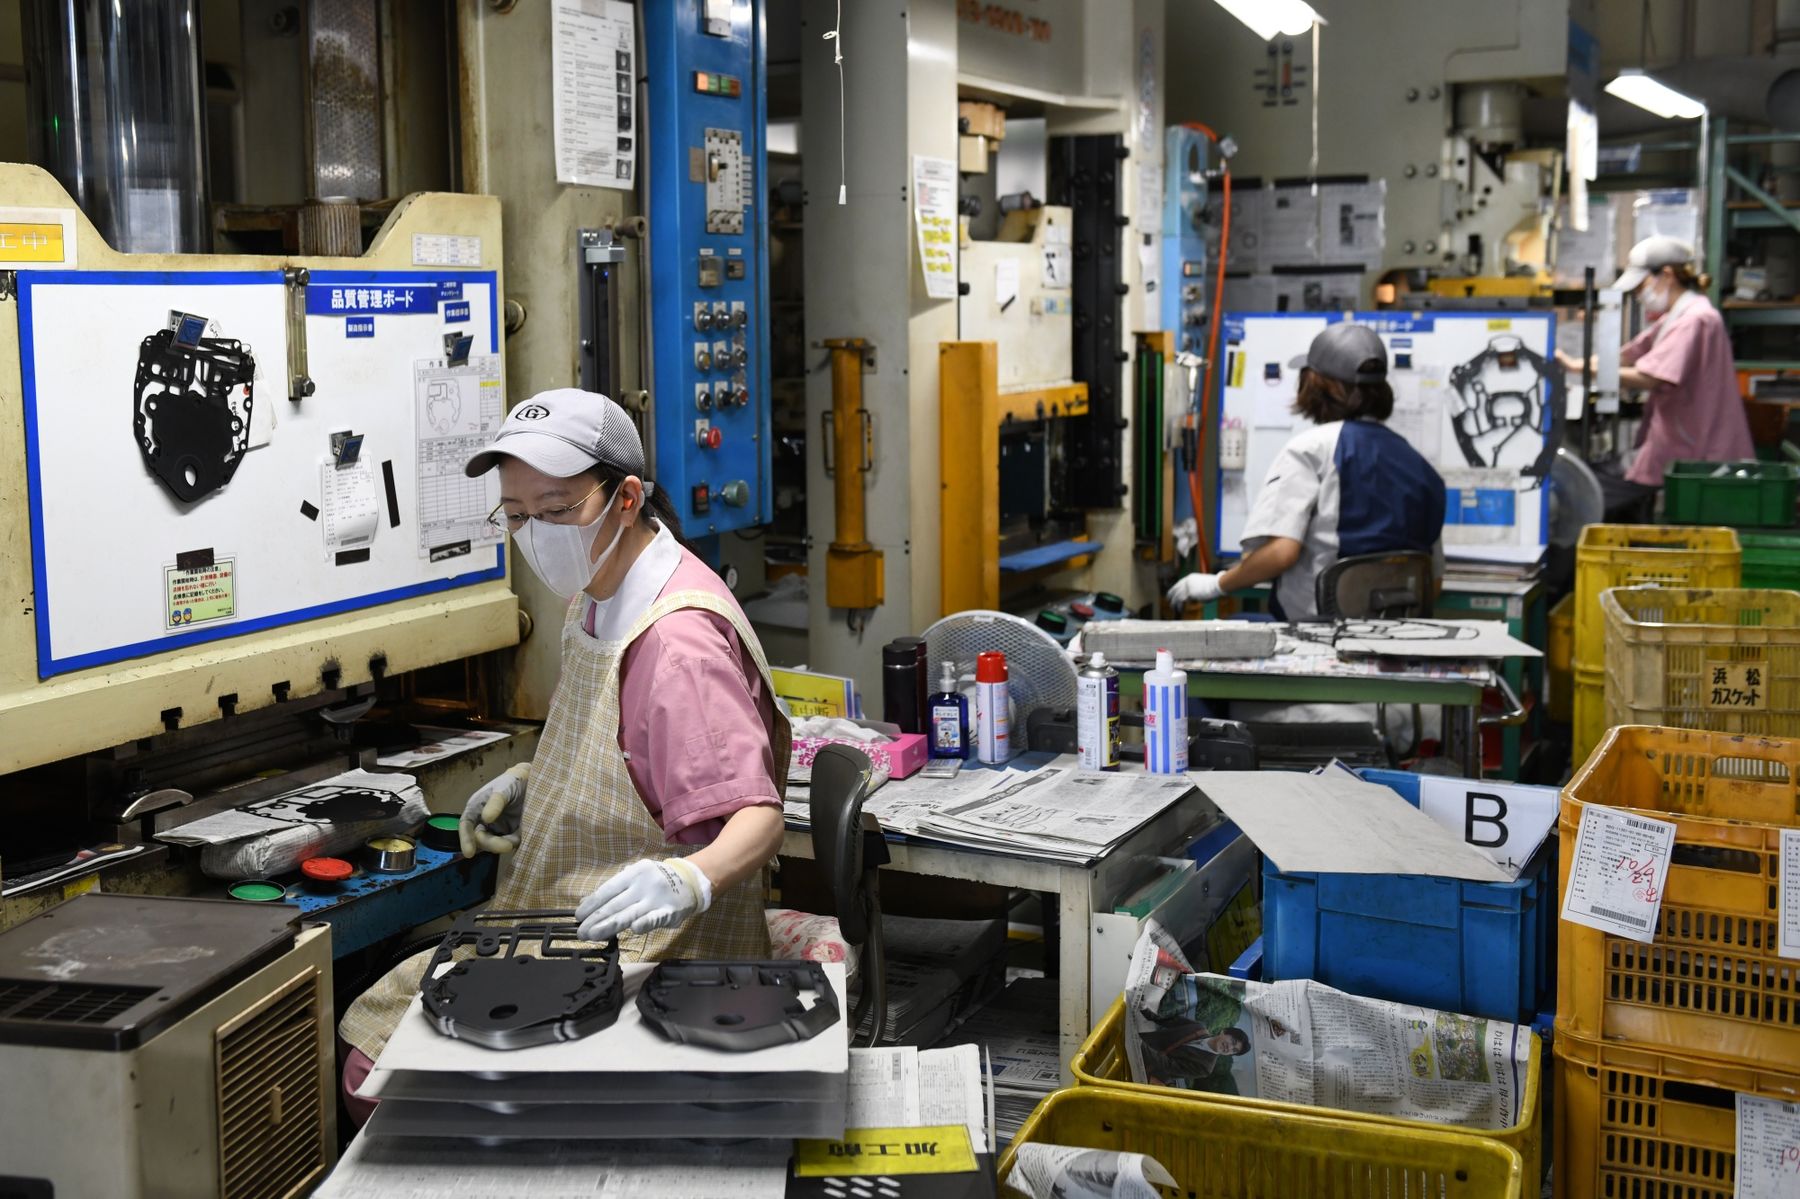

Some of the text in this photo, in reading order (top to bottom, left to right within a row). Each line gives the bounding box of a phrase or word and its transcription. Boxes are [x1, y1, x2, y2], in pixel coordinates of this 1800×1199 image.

[331, 289, 414, 309] 品質管理ボード
[525, 408, 539, 419] G
[1712, 667, 1761, 686] 浜松
[1711, 688, 1761, 706] ガスケット
[1465, 791, 1509, 848] B
